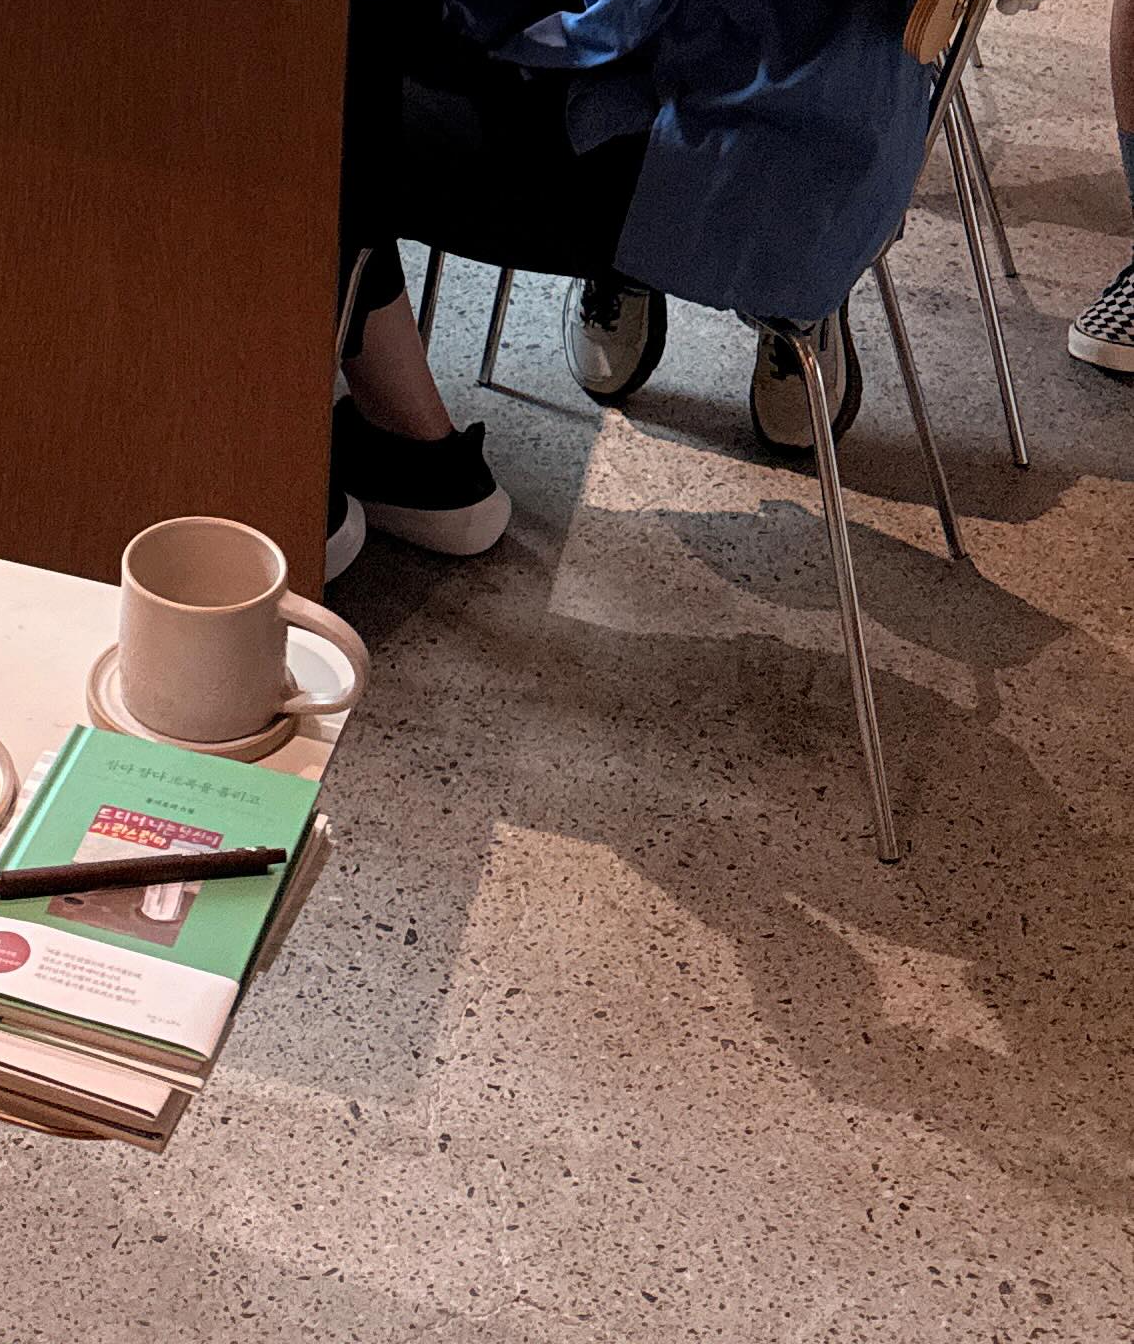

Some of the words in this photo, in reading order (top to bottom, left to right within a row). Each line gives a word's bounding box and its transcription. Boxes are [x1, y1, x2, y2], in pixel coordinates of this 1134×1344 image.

[91, 821, 167, 848] 사랑스럽다
[97, 807, 147, 827] 드디어
[148, 819, 177, 837] 나는
